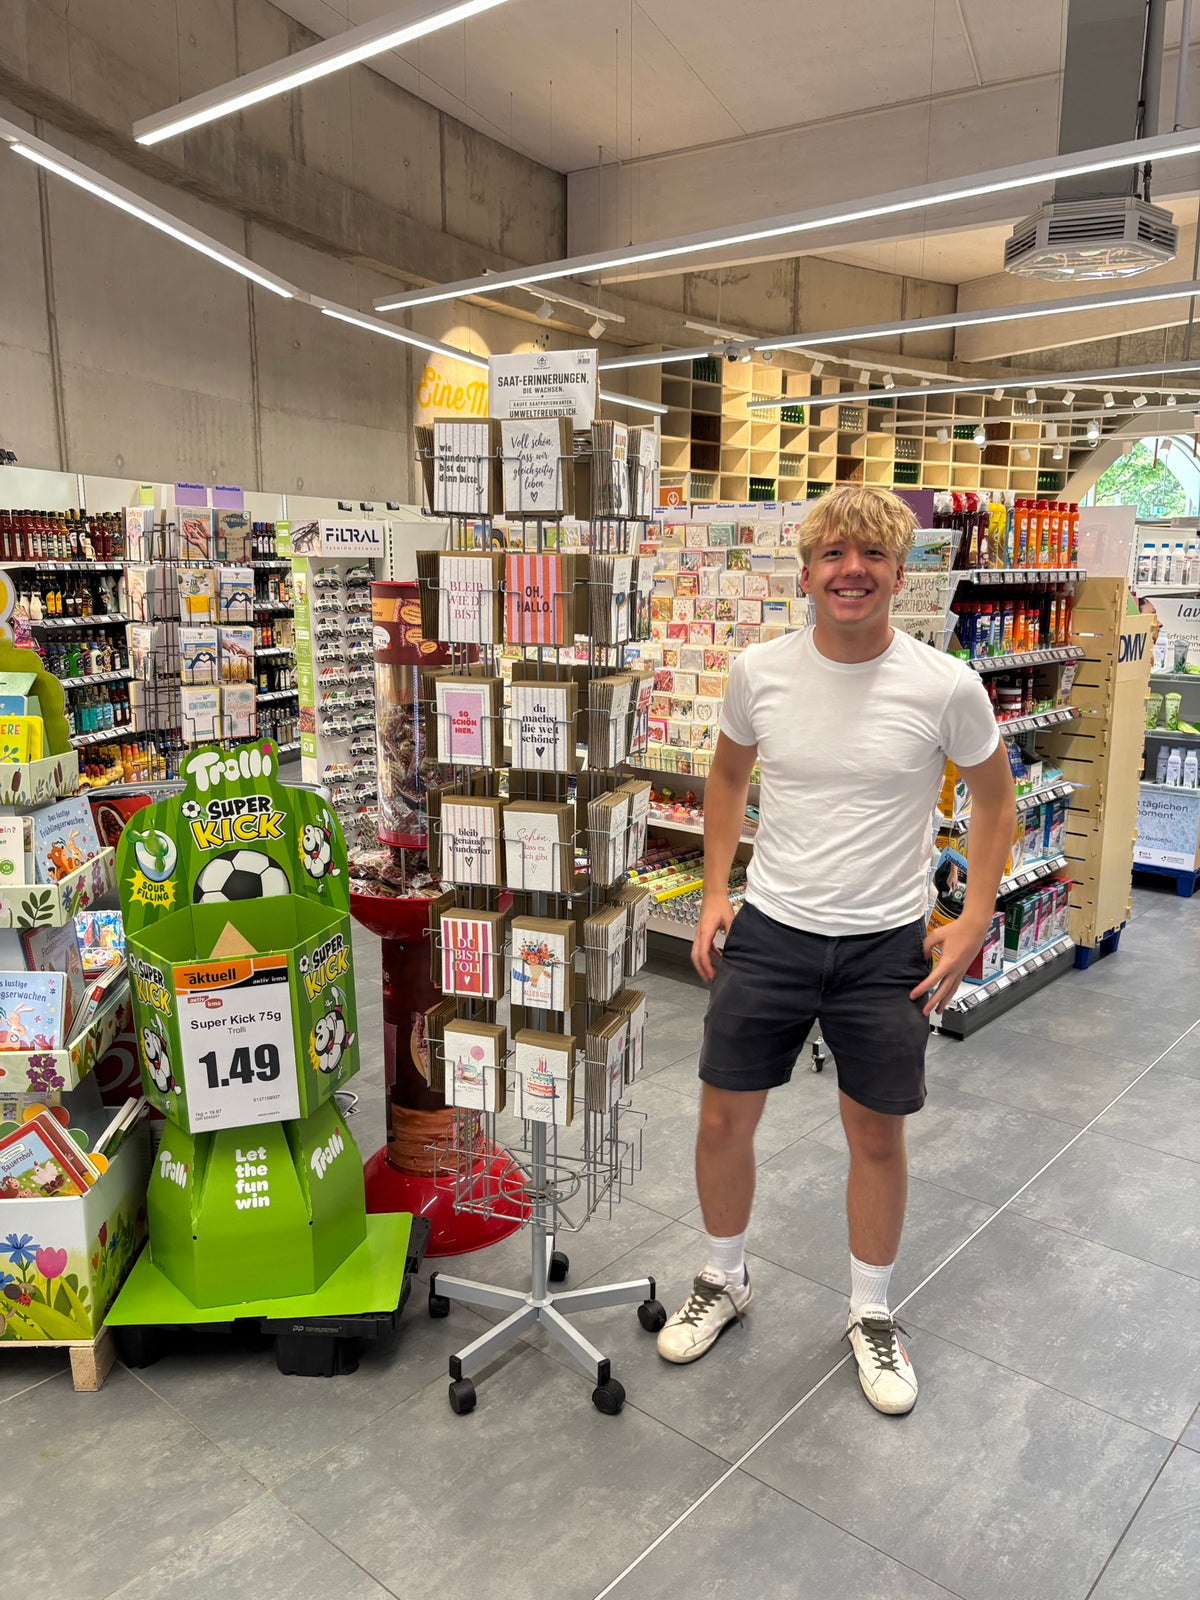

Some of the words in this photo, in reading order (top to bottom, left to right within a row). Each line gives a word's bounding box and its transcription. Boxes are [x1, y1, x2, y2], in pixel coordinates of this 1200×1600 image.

[498, 373, 589, 387] SAAT-ERINNERUNGEN,
[509, 408, 578, 417] UMWELTFREUNDLICH.
[511, 433, 529, 448] Voll
[439, 444, 452, 452] wie
[535, 451, 548, 460] wir
[439, 463, 454, 473] bist
[456, 464, 466, 473] du
[513, 463, 554, 480] gleichzeitig
[439, 474, 457, 483] denn
[459, 474, 478, 484] bitte
[524, 477, 544, 489] leben
[450, 581, 483, 591] BLEIB
[911, 578, 934, 591] HAPPY
[526, 586, 543, 599] OH,
[448, 596, 470, 606] WIE
[516, 600, 553, 613] HALLO.
[899, 600, 933, 612] BIRTHDAY
[454, 609, 478, 620] BIST
[1118, 633, 1147, 663] DMV
[533, 703, 546, 713] du
[451, 717, 477, 726] SCHÖN
[522, 714, 557, 723] machst
[454, 726, 474, 734] HIER.
[521, 724, 536, 733] die
[539, 724, 559, 734] welt
[521, 734, 559, 744] schöner
[187, 744, 272, 791] Trolli
[208, 796, 271, 819] SUPER
[1143, 801, 1189, 812] täglichen
[47, 813, 56, 822] Das
[55, 809, 71, 820] lustige
[40, 817, 85, 838] Frühlingserwachen
[192, 812, 285, 849] KICK
[458, 828, 478, 837] bleib
[454, 837, 486, 846] genauso
[449, 845, 492, 856] wunderbar
[535, 853, 548, 861] gibt
[141, 881, 165, 893] SOUR
[137, 887, 169, 901] FILLING
[457, 938, 475, 948] DU
[313, 934, 344, 967] SUPER
[455, 951, 480, 961] BIST
[138, 961, 164, 987] SUPER
[188, 968, 237, 985] aktuell
[305, 947, 350, 1000] KICK
[5, 980, 28, 988] lustige
[134, 975, 173, 1016] KICK
[190, 1017, 227, 1030] Super
[230, 1013, 256, 1025] Kick
[259, 1011, 281, 1024] 75g
[227, 1026, 247, 1035] Trolli
[199, 1043, 281, 1088] 1.49
[235, 1147, 266, 1162] Let
[311, 1127, 344, 1180] Trolli
[1, 1149, 34, 1172] Bauernhof
[160, 1150, 189, 1189] Trolli
[235, 1162, 268, 1178] the
[235, 1178, 268, 1194] fun
[235, 1194, 270, 1210] win
